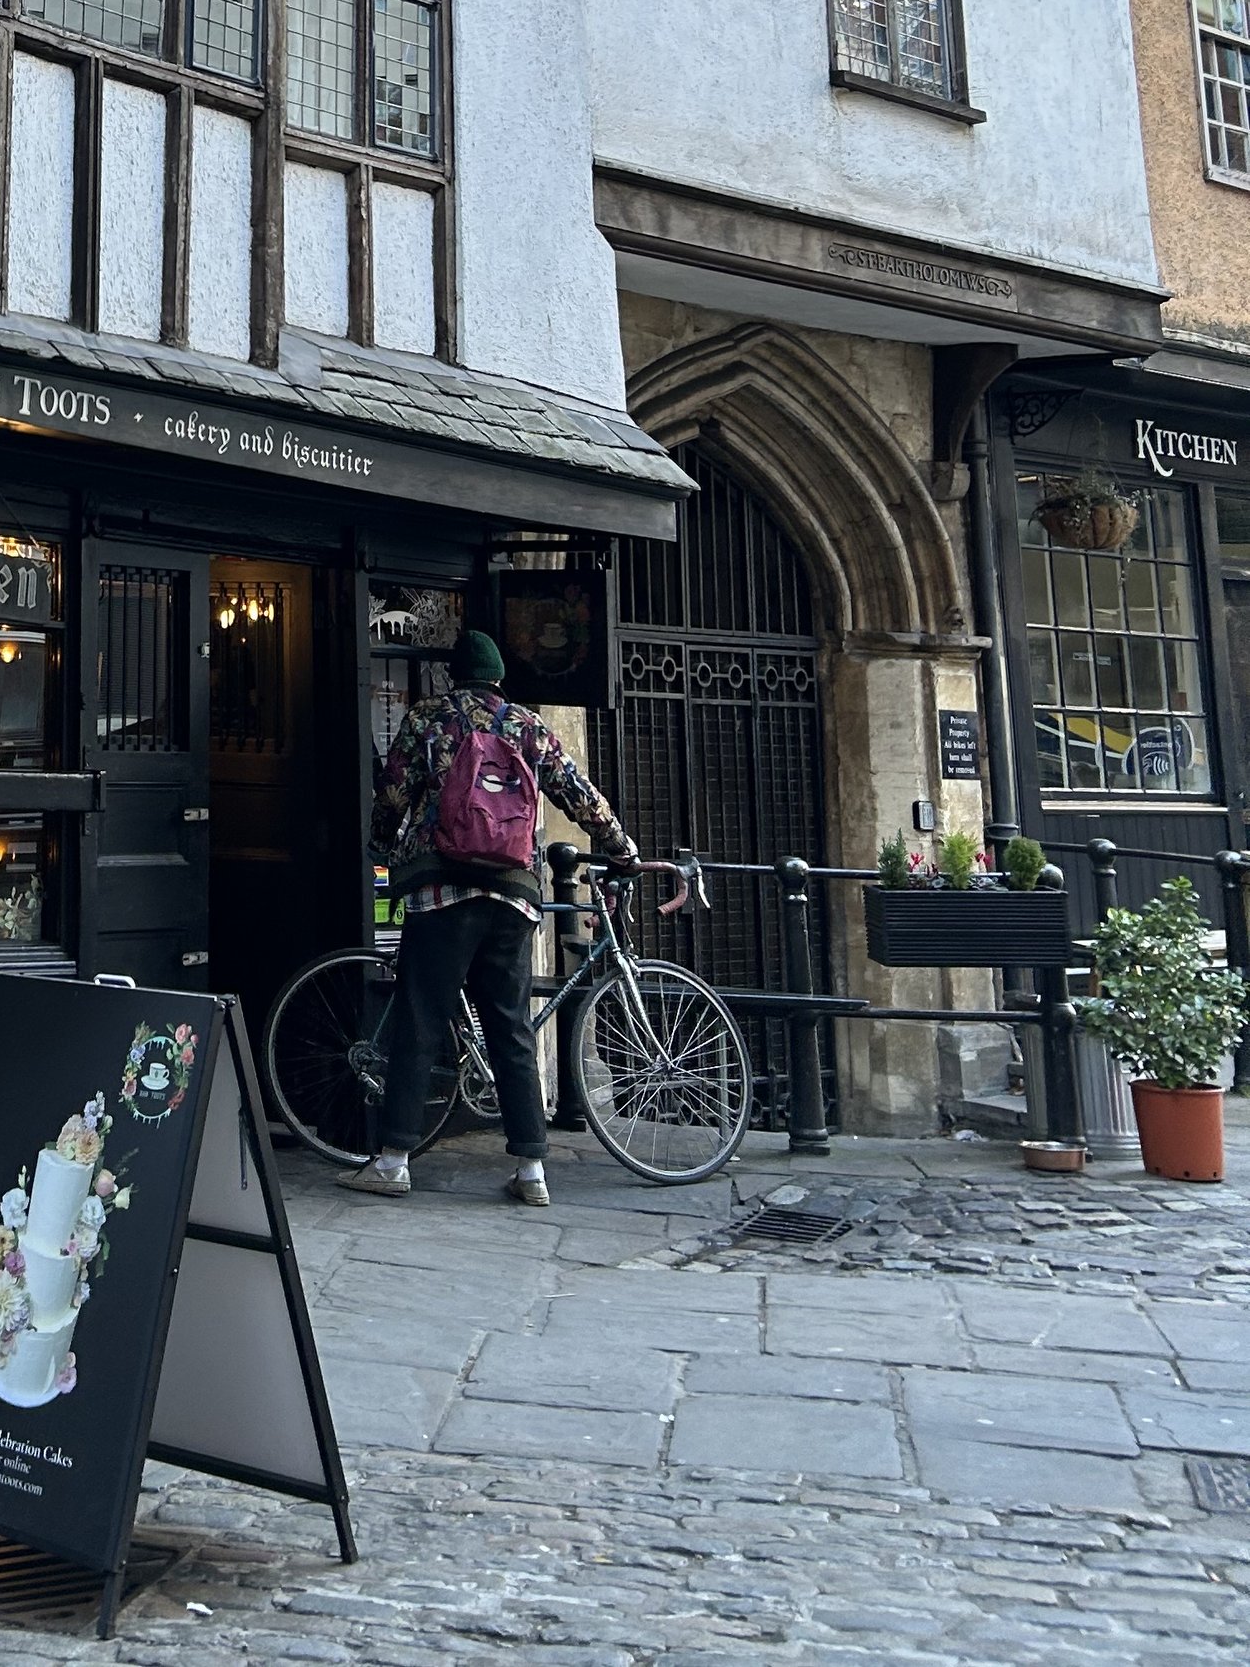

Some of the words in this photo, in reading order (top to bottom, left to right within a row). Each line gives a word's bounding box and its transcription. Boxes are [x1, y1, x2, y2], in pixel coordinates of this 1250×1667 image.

[13, 375, 111, 425] TOOTS
[164, 411, 231, 455] cakery
[240, 426, 274, 456] and
[282, 431, 374, 476] biscuitier
[1135, 419, 1238, 477] KITCHEN
[3, 1455, 32, 1475] online
[43, 1445, 74, 1469] Cakes
